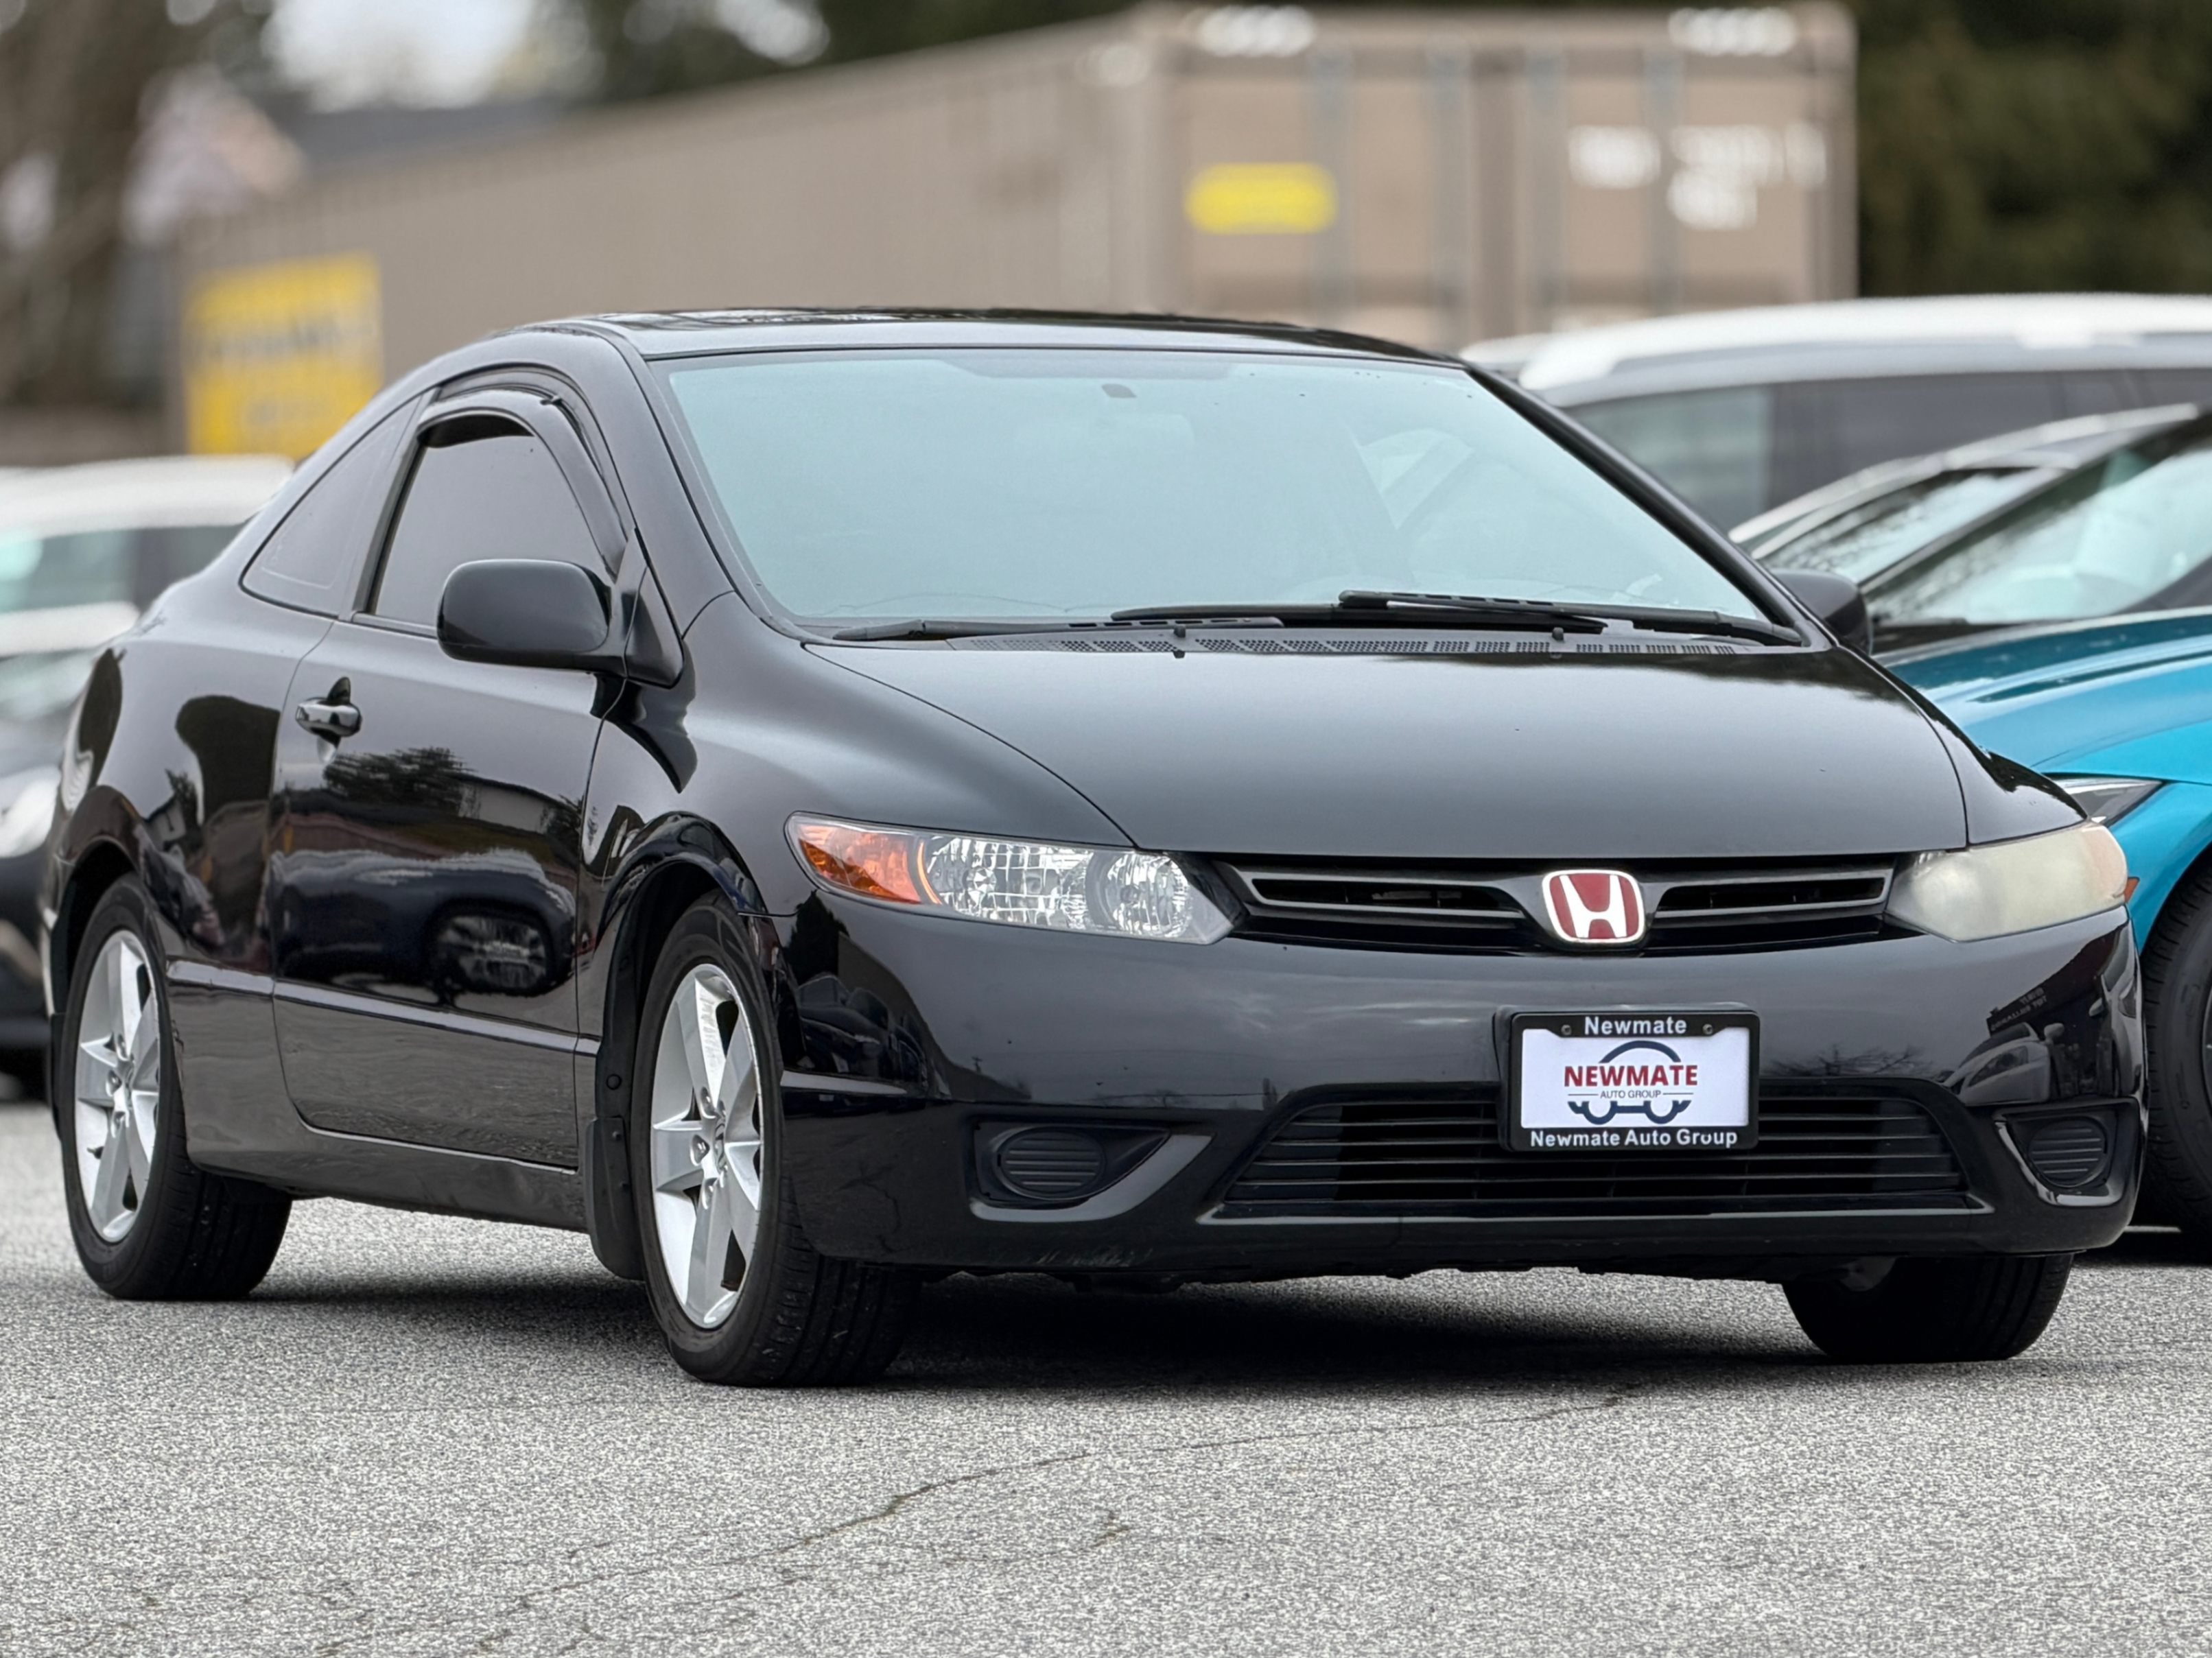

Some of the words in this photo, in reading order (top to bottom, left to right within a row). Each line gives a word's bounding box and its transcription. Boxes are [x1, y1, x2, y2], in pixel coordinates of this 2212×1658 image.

[1585, 1017, 1686, 1034] Newmate
[1564, 1065, 1697, 1087] NEWMATE
[1601, 1090, 1625, 1098] AUTO
[1628, 1089, 1661, 1098] GROUP
[1531, 1130, 1620, 1146] Newmate
[1625, 1130, 1671, 1146] Auto
[1677, 1129, 1737, 1148] Group
